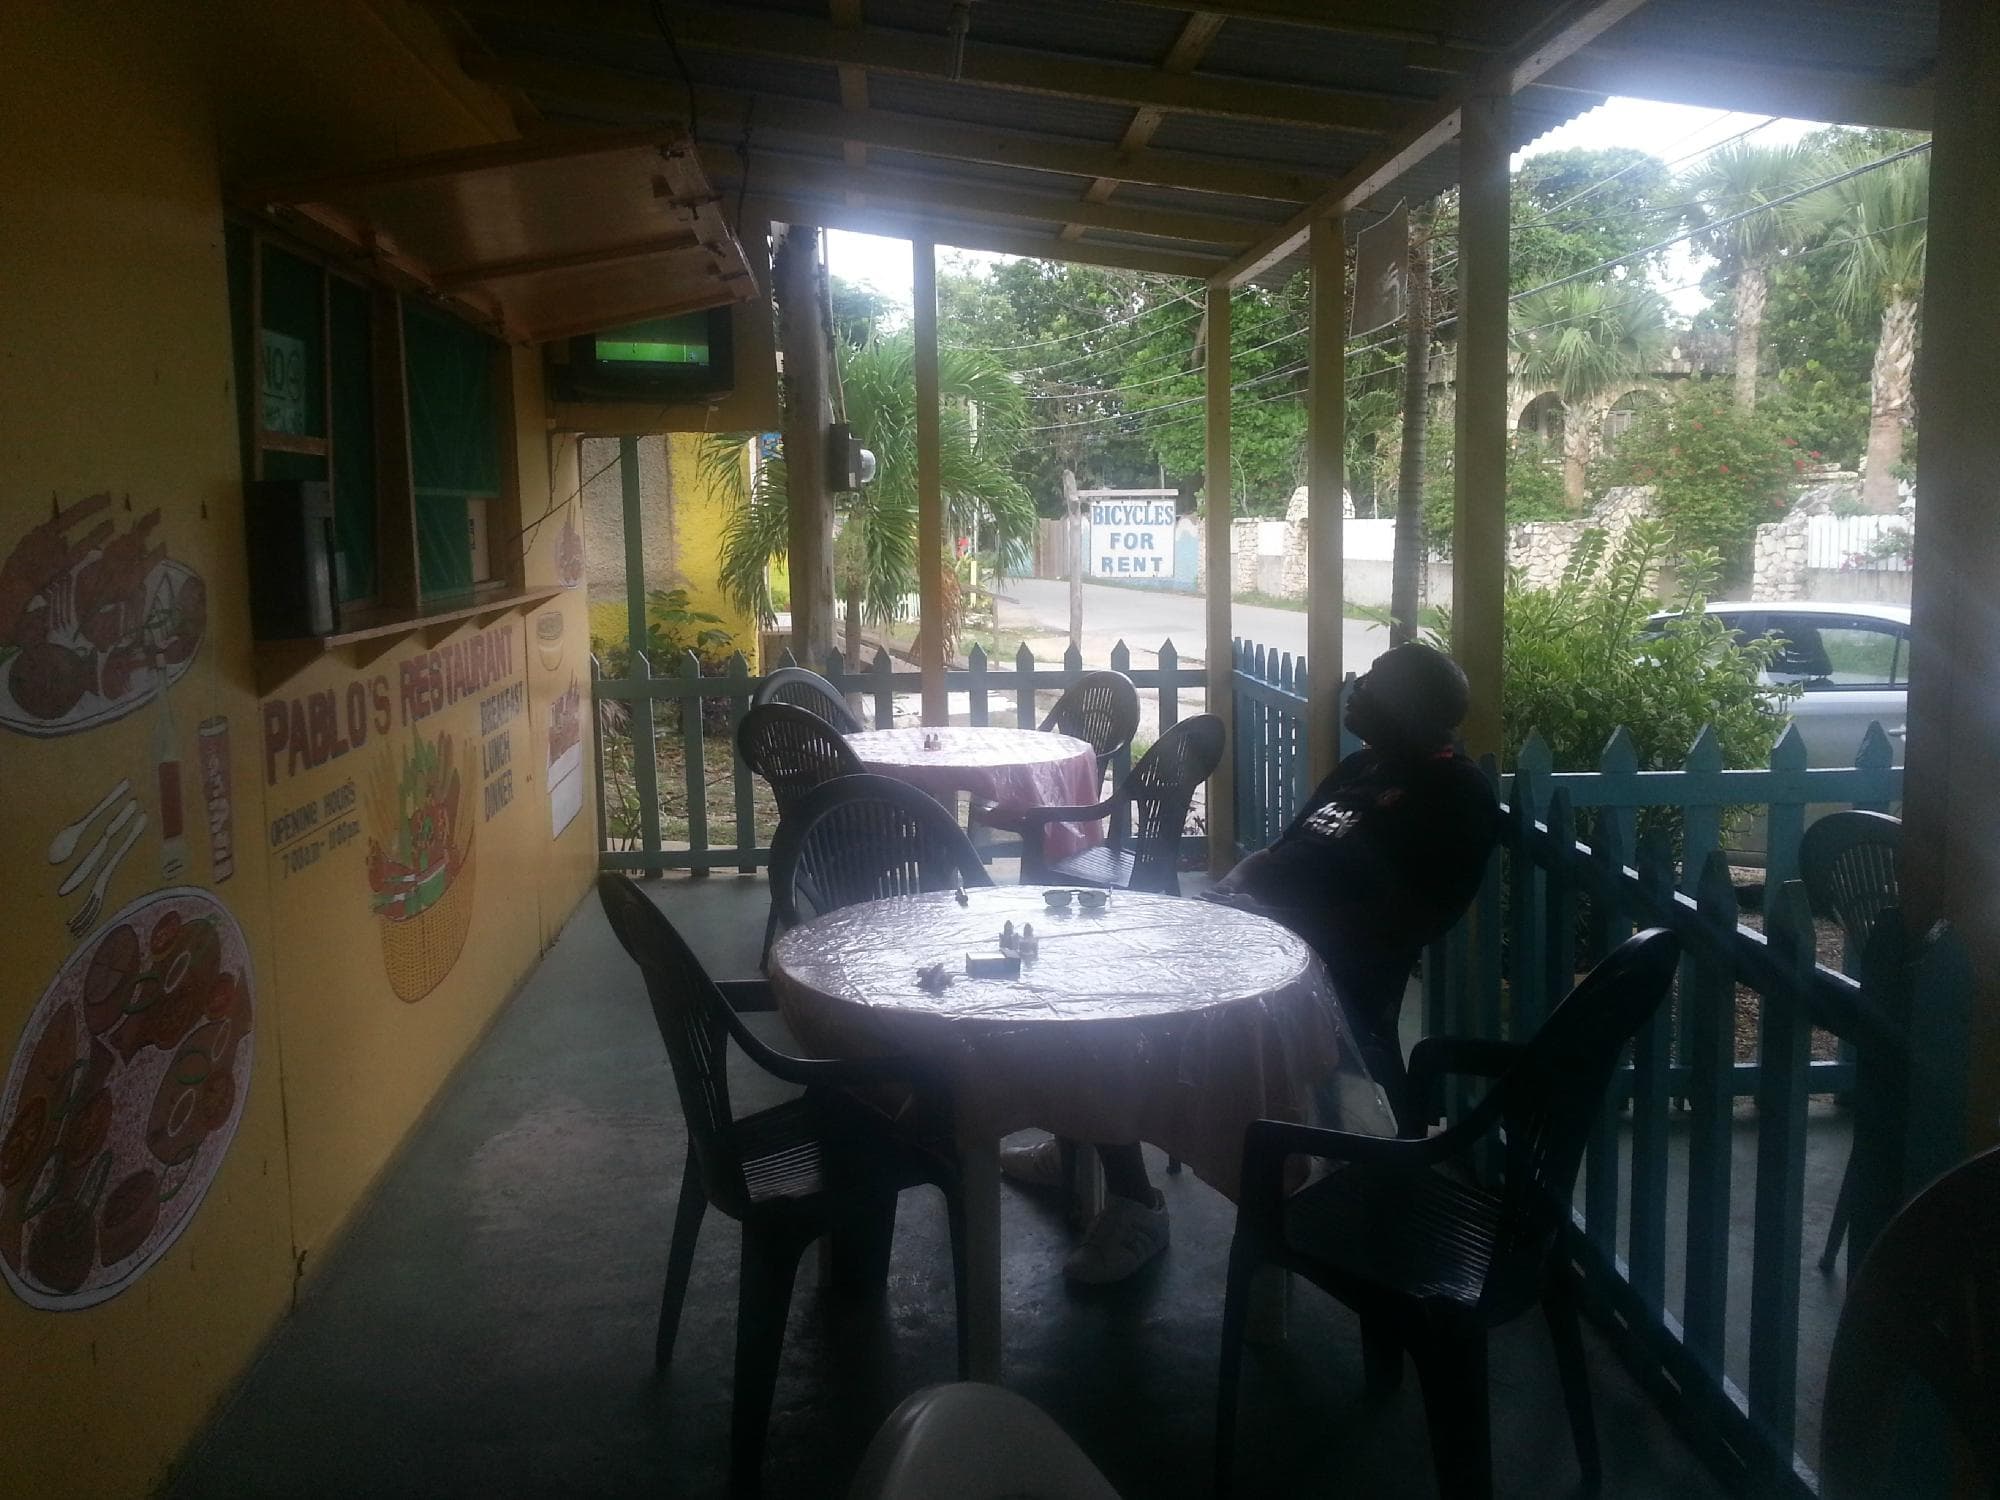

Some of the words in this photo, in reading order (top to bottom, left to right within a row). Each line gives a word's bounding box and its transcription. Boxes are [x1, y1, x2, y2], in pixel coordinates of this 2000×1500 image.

[1092, 505, 1174, 525] BICYCLES
[1110, 533, 1154, 549] FOR
[1101, 557, 1162, 572] RENT
[264, 675, 391, 786] PABLO'S
[400, 626, 512, 728] RESTAURANT
